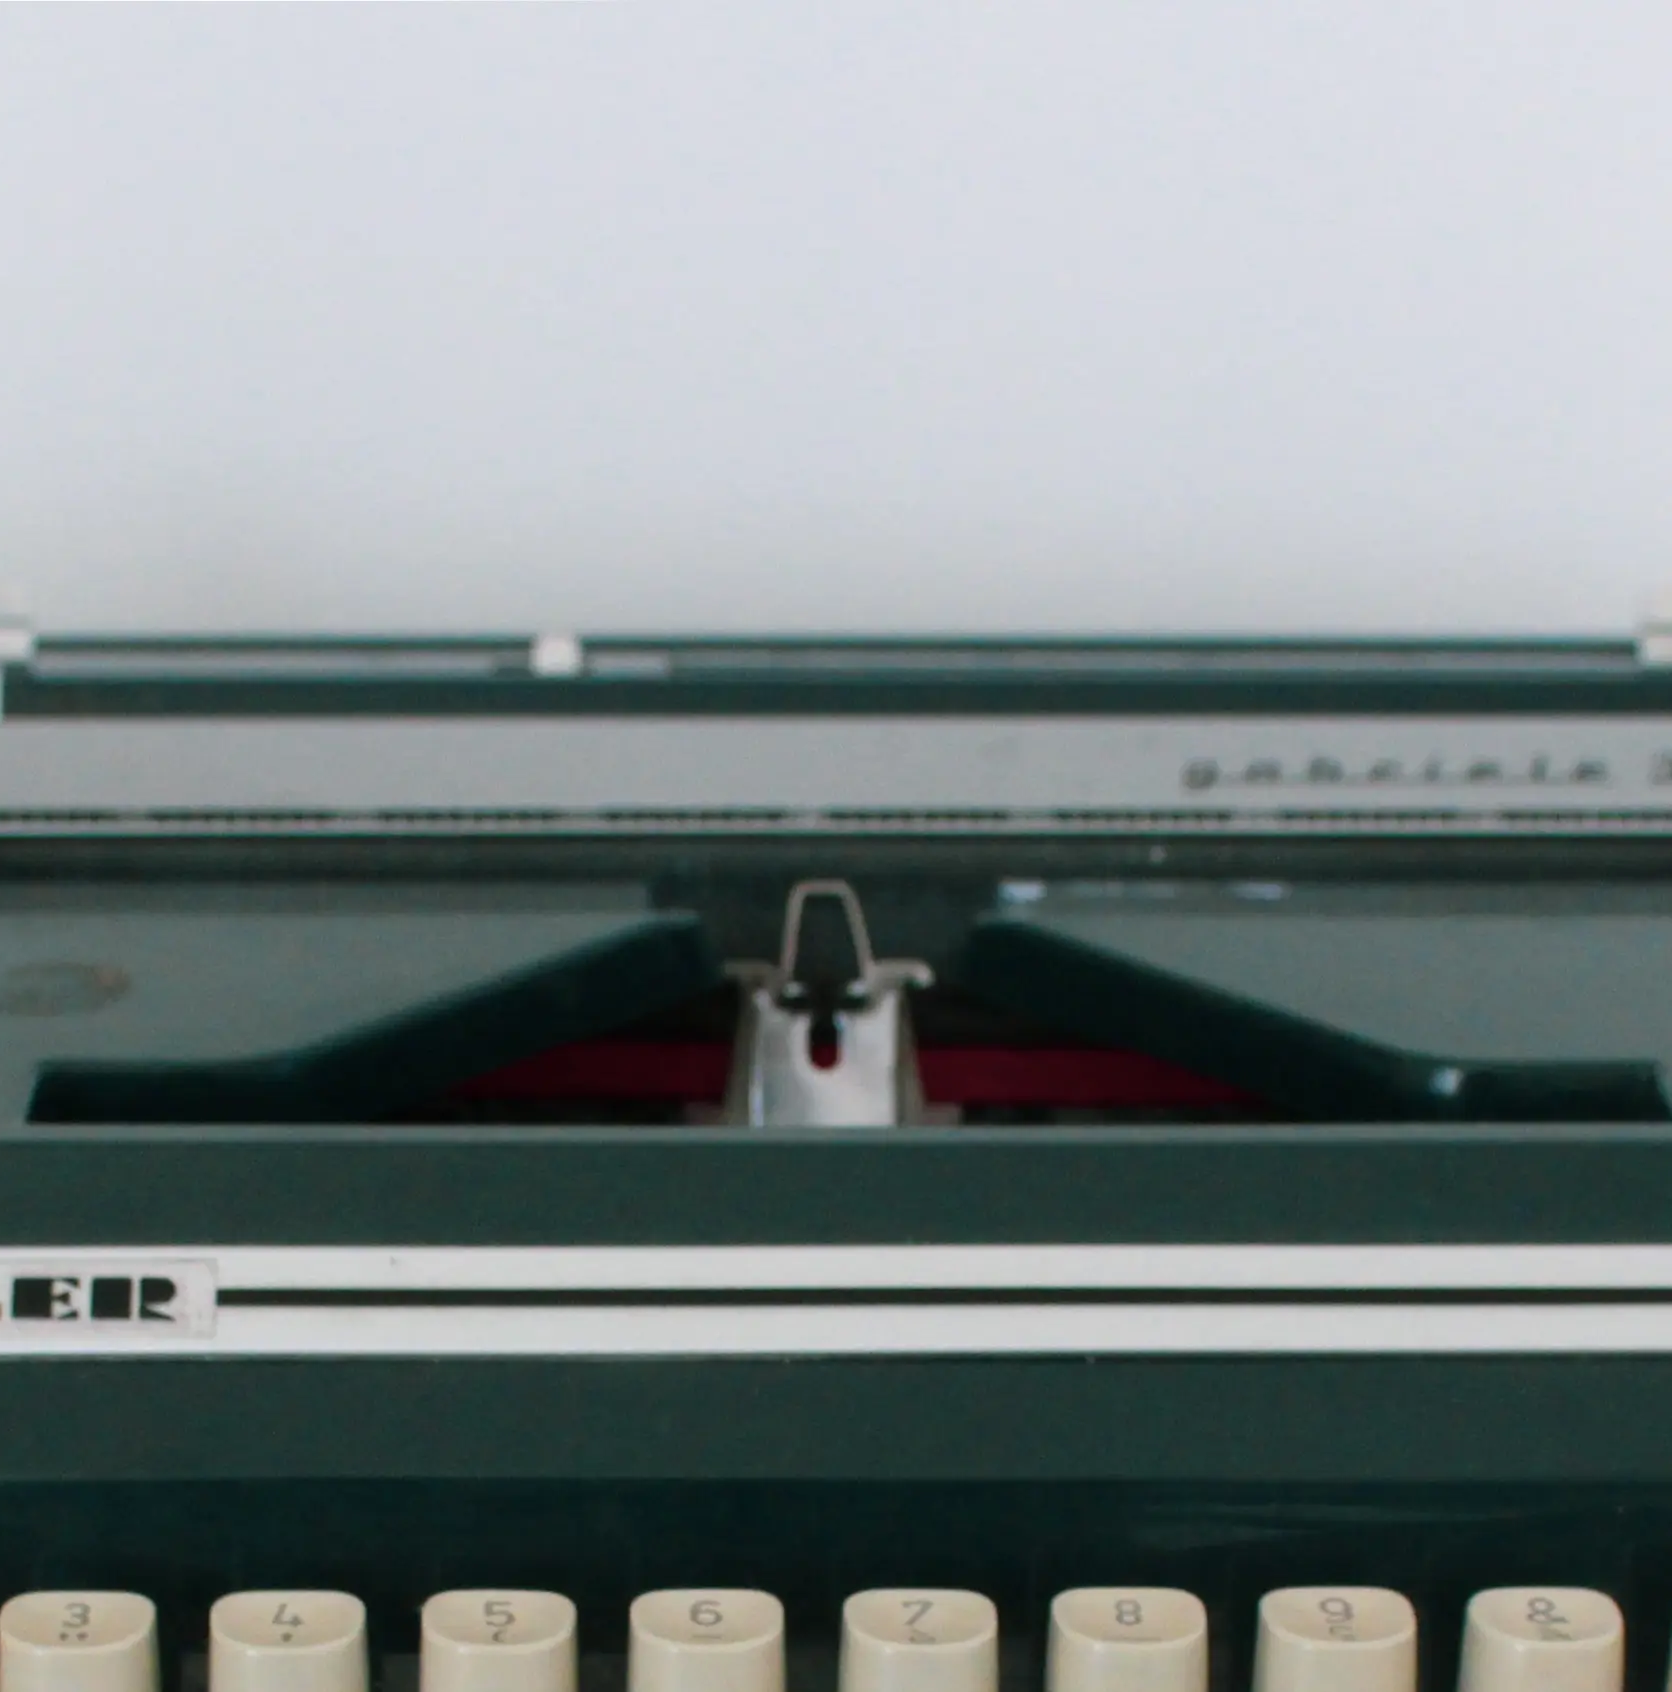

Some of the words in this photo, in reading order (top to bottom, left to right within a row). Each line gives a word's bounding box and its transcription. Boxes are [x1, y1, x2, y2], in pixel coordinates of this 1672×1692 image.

[63, 1603, 90, 1628] 3
[272, 1604, 304, 1628] 4
[484, 1601, 516, 1628] 5
[689, 1600, 723, 1627] 6
[902, 1600, 933, 1627] 7
[1115, 1600, 1143, 1626] 8
[1318, 1598, 1354, 1623] 9
